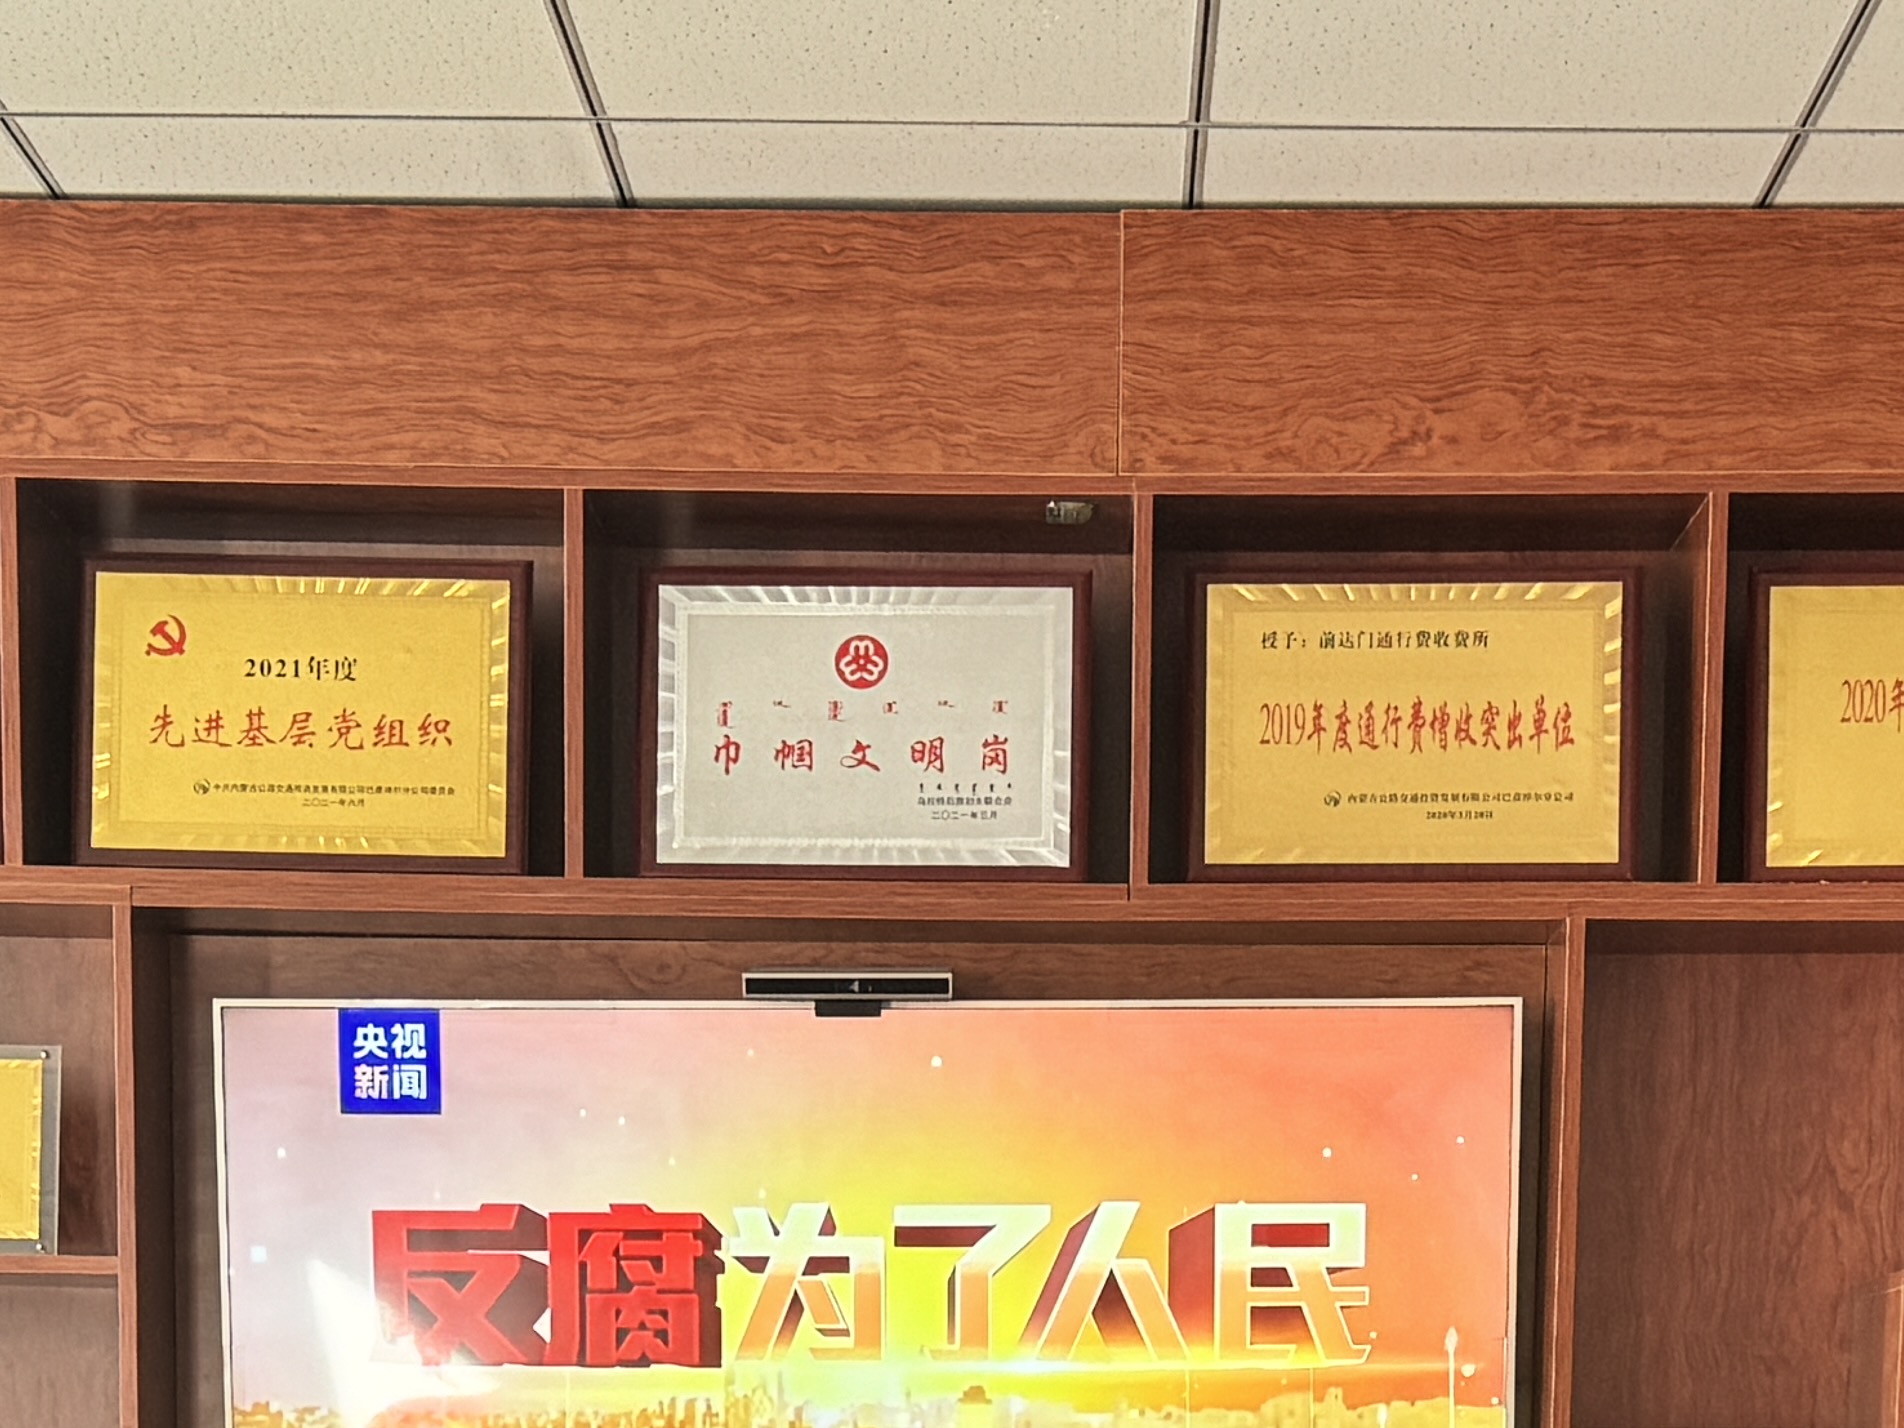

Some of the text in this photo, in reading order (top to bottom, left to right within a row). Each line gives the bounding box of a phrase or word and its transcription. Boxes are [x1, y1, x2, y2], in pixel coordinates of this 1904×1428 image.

[244, 656, 357, 682] 2021年度
[149, 704, 454, 752] 先进基层党组织
[713, 734, 1010, 776] 巾帼文明岗
[352, 1025, 429, 1062] 央视
[353, 1065, 428, 1102] 新闻
[368, 1202, 1374, 1370] 反腐为了人民
